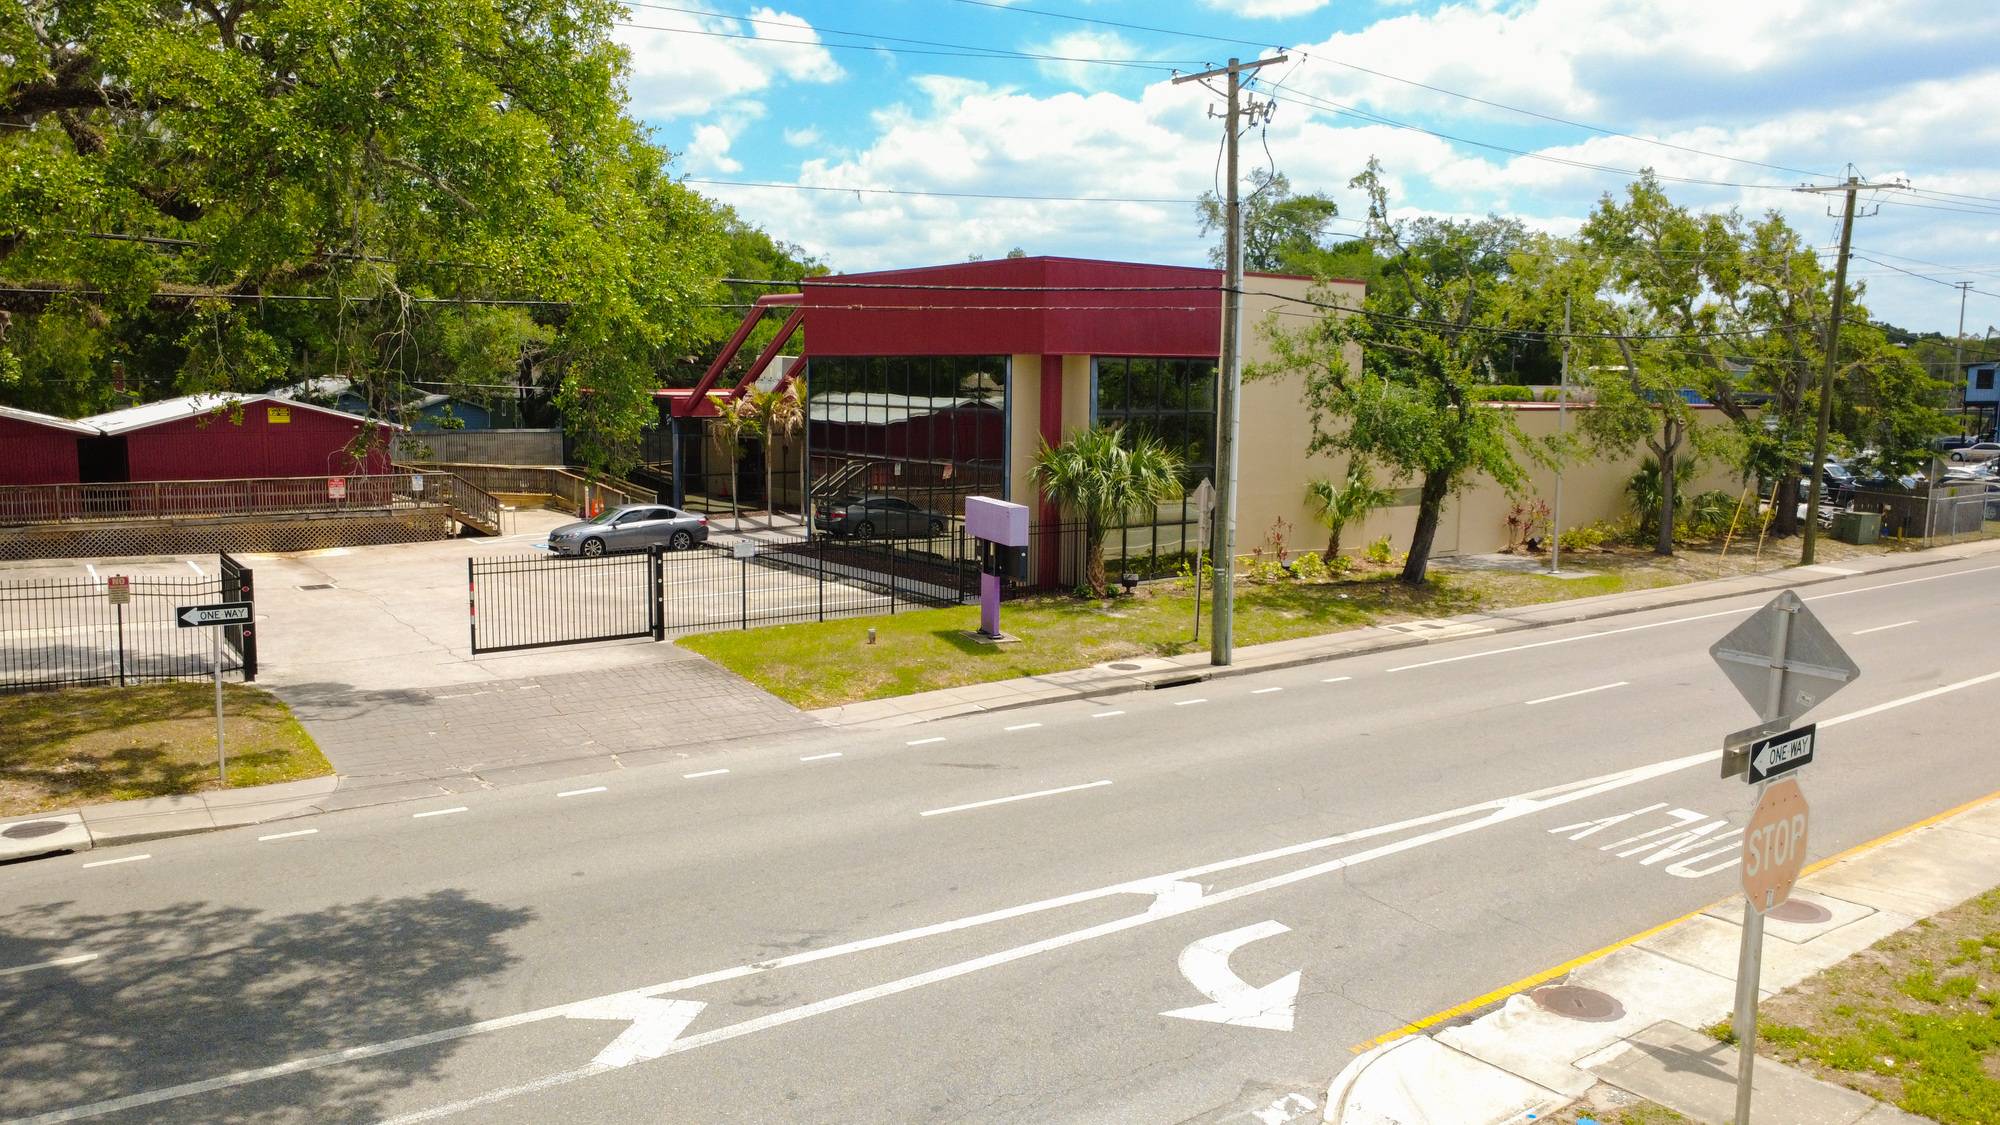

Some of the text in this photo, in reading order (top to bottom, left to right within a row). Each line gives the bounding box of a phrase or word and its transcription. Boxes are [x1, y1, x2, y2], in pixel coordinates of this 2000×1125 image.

[200, 609, 245, 620] ONE WAY
[1769, 737, 1809, 765] ONE WAY
[1747, 813, 1806, 877] STOP
